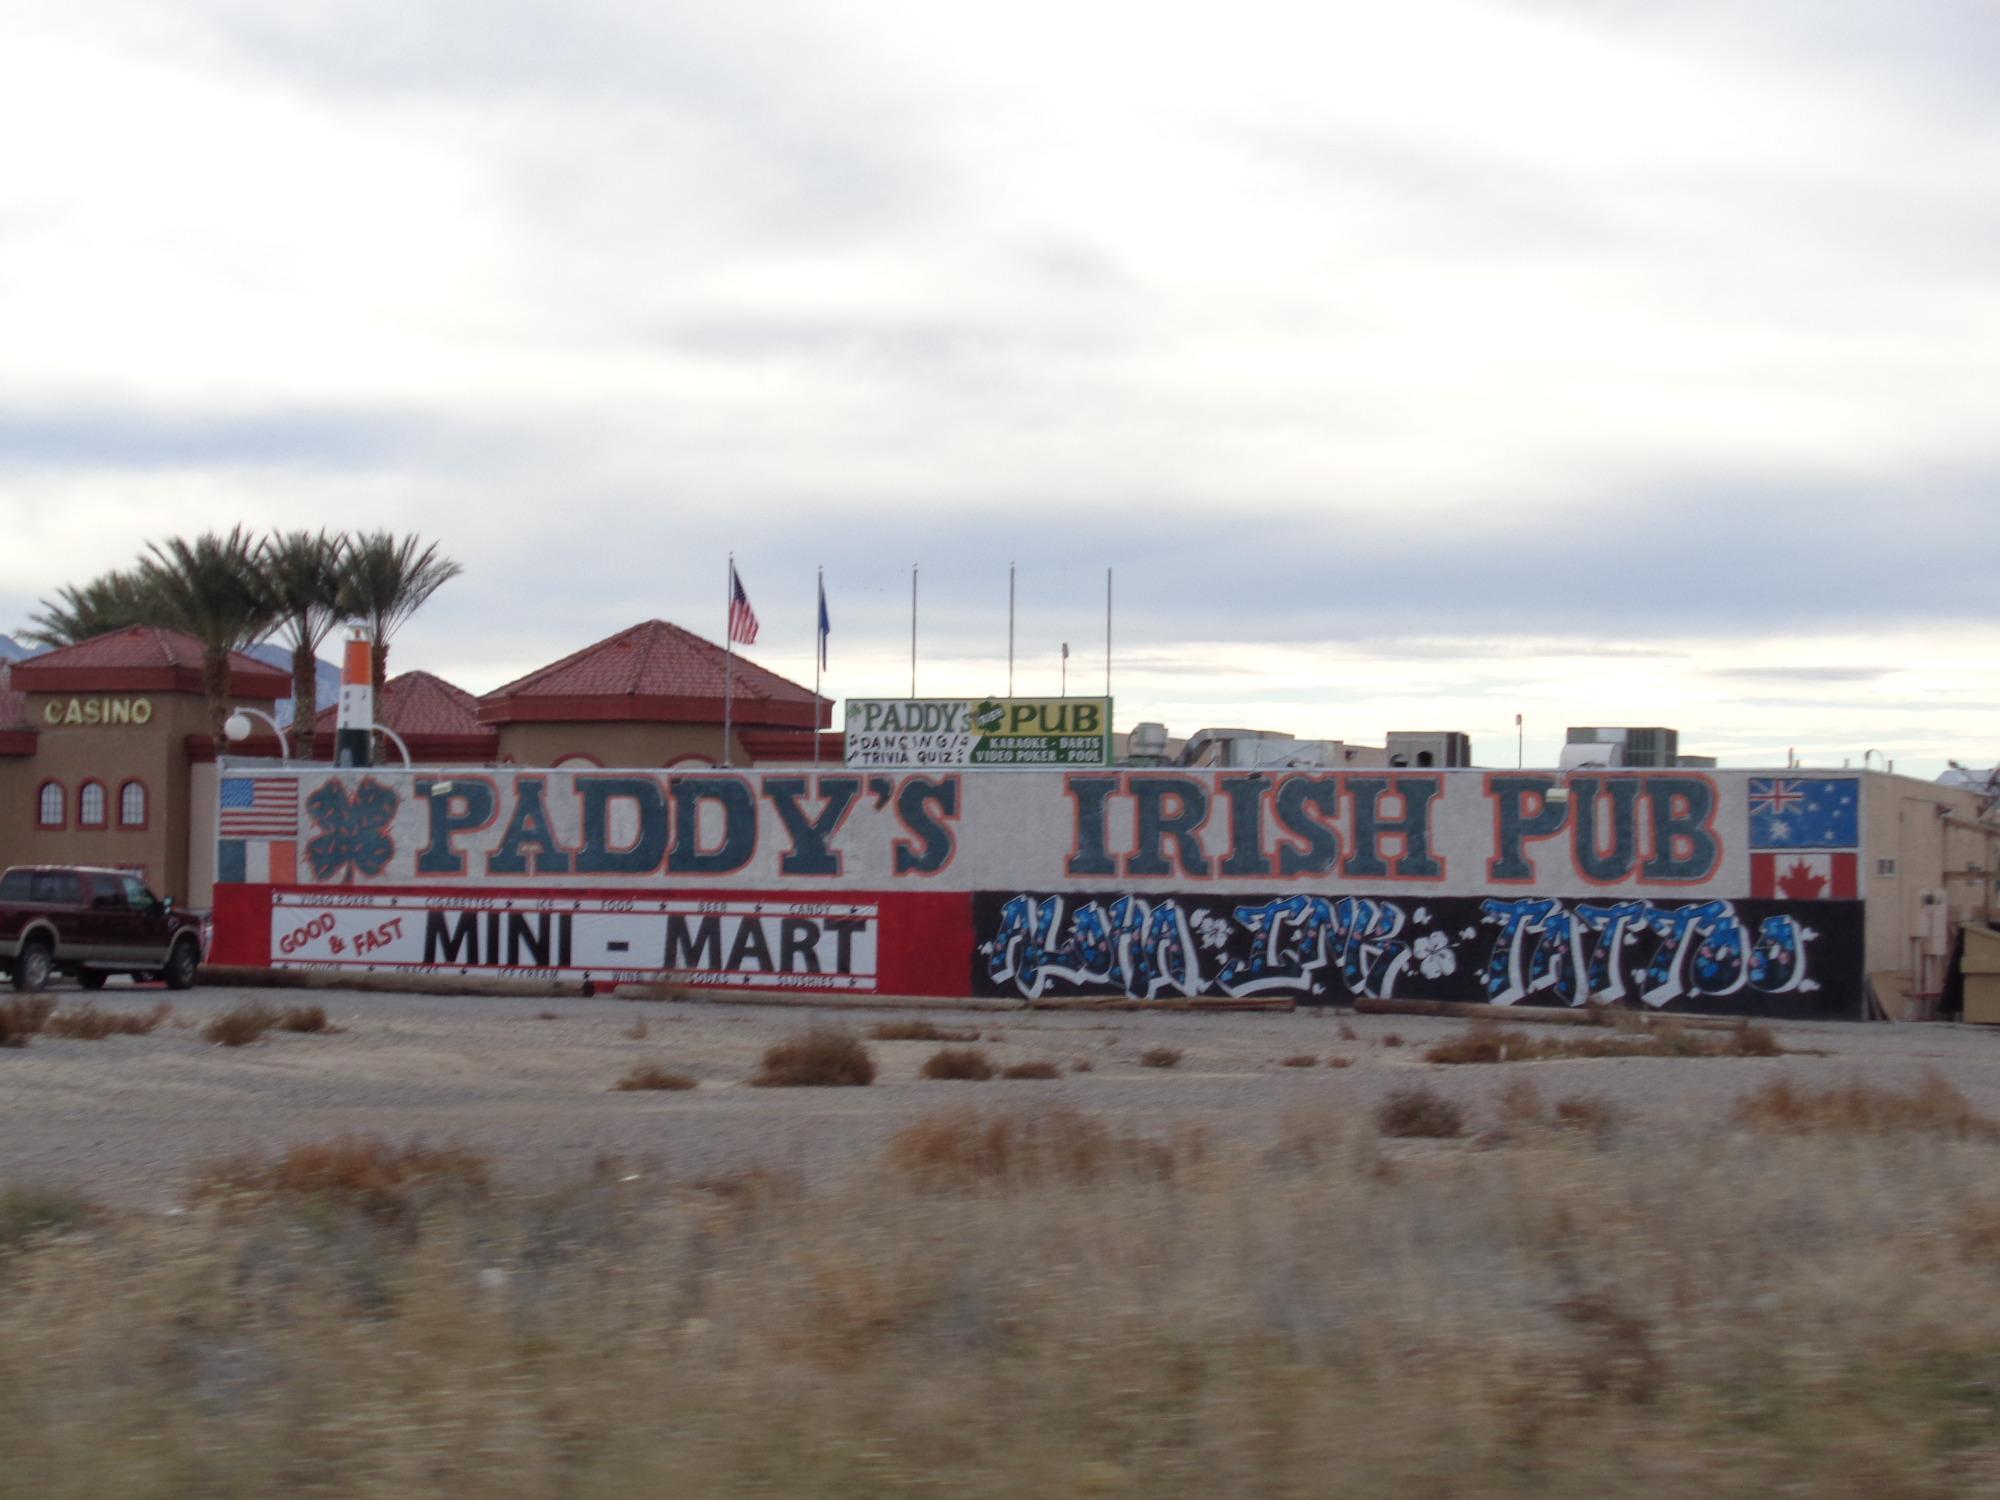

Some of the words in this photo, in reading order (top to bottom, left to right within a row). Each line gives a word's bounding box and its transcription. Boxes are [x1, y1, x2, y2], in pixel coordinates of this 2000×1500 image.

[44, 698, 152, 725] CASINO
[1010, 704, 1100, 733] PUB
[864, 751, 909, 764] TRIVIA
[917, 751, 953, 764] QUIZ
[976, 750, 1013, 763] VIDEO
[1016, 750, 1057, 763] POKER
[1068, 750, 1101, 763] POOL
[989, 738, 1048, 750] KARAOKE
[1060, 738, 1100, 750] DARTS
[415, 773, 961, 878] PADDY'S
[1063, 771, 1446, 883] IRISH
[1484, 771, 1723, 886] PUB
[279, 912, 336, 955] GOOD
[328, 936, 346, 955] &
[352, 917, 405, 957] FAST
[424, 911, 571, 967] MINI
[664, 915, 866, 974] MART
[1480, 898, 1807, 1008] TATTOO
